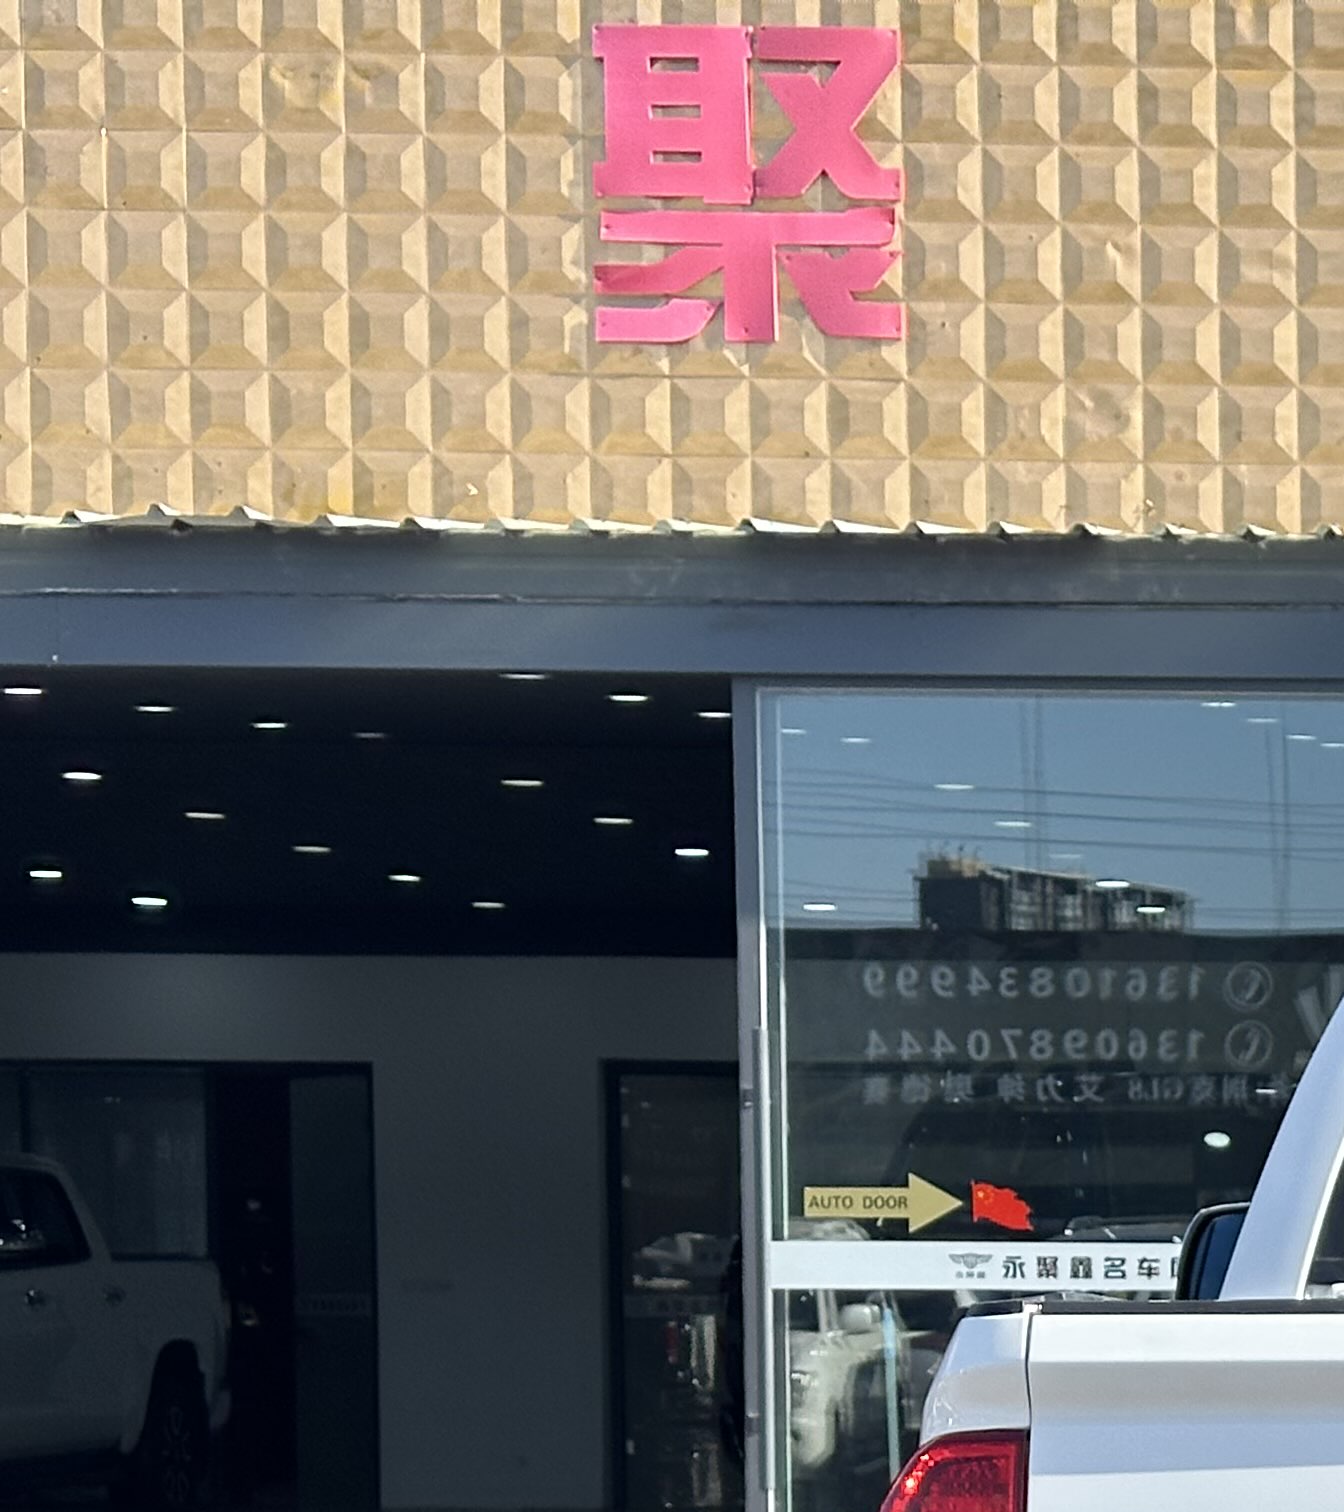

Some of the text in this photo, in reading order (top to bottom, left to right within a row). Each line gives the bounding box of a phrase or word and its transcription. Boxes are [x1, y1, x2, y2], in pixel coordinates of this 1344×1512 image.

[593, 25, 906, 343] 聚
[808, 1195, 908, 1209] AUTO DOOR
[1002, 1255, 1179, 1280] 永聚鑫名车
